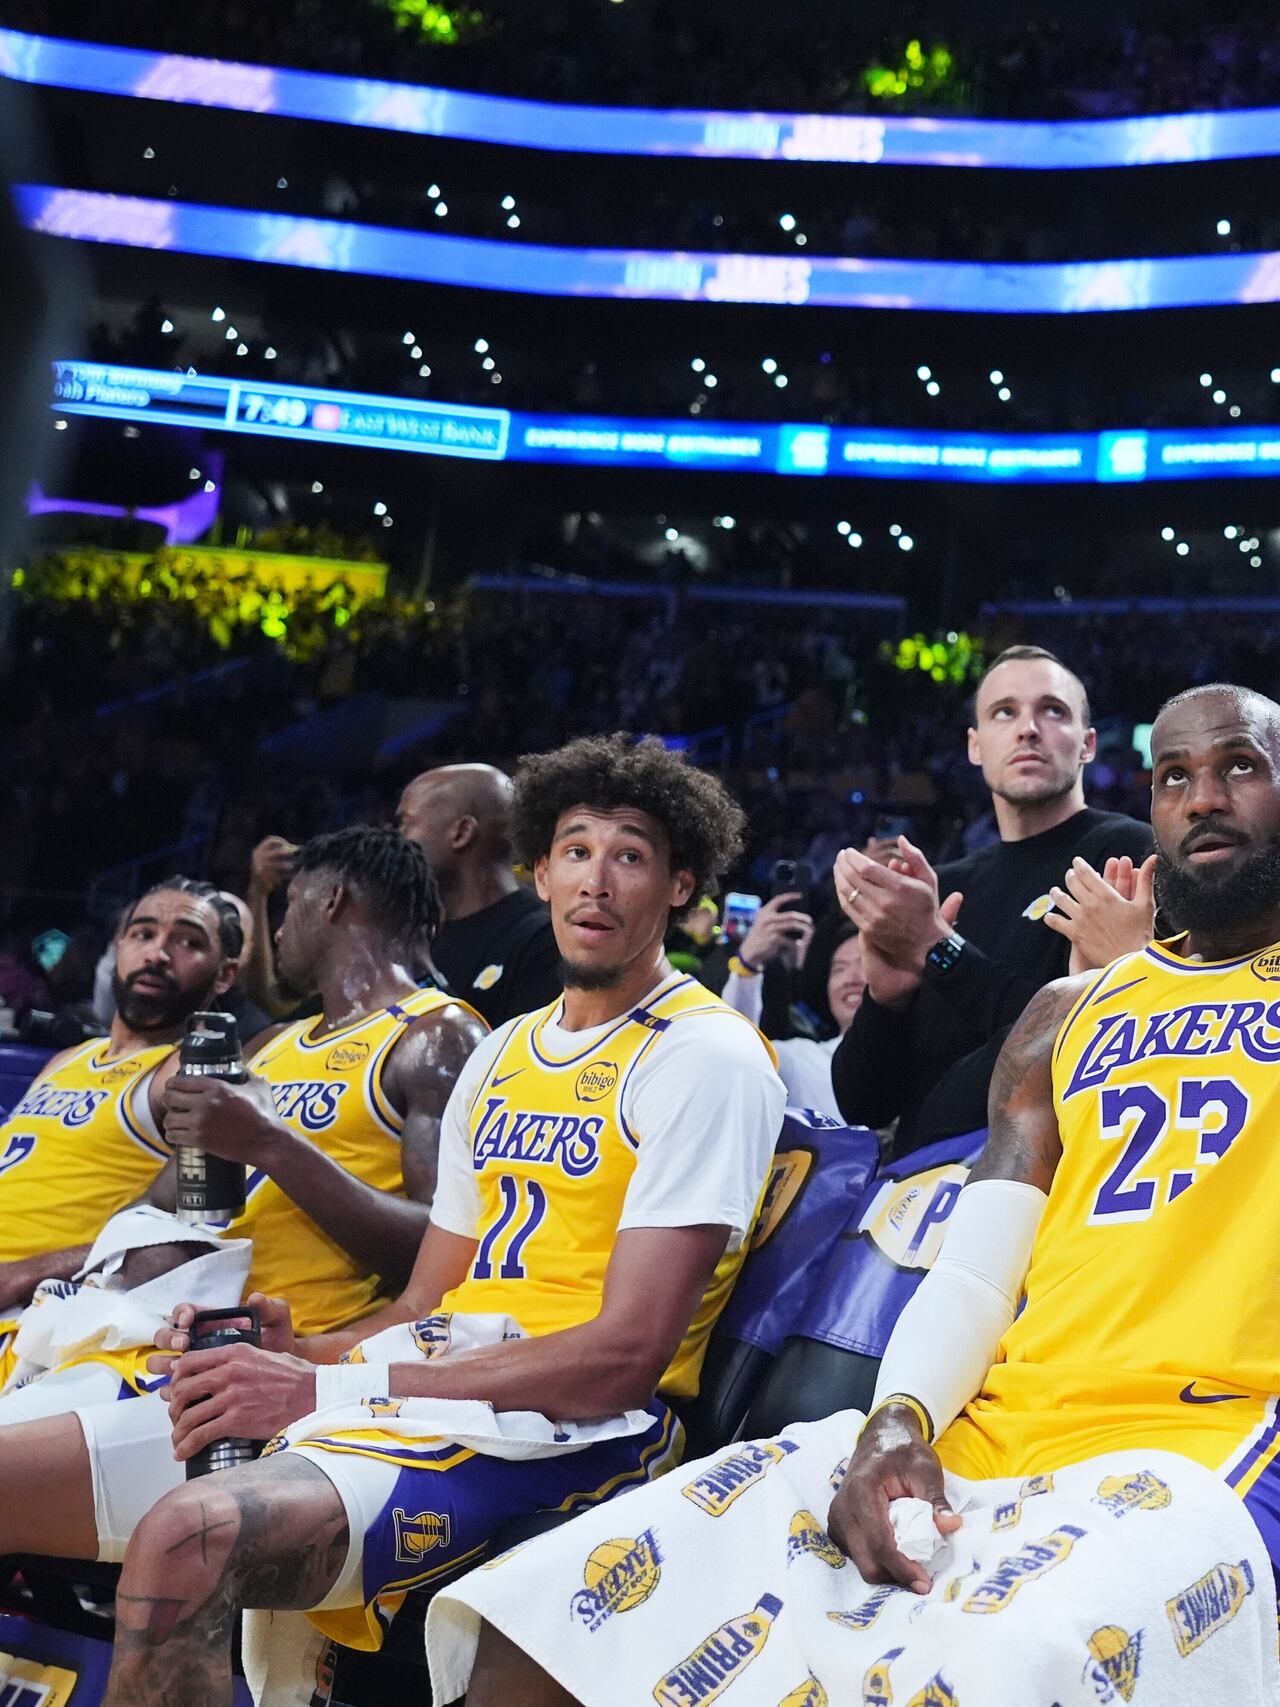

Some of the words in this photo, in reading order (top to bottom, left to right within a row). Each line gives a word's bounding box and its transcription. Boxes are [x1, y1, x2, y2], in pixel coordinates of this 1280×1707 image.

[244, 393, 308, 427] 7:49
[580, 1071, 615, 1091] bibigo
[473, 1098, 604, 1177] LAKERS
[1086, 1077, 1249, 1225] 23
[473, 1175, 547, 1280] 11
[694, 1443, 773, 1504] PRIME
[570, 1526, 666, 1625] LAKERS
[1176, 1567, 1231, 1643] PRIME
[665, 1624, 754, 1707] PRIME
